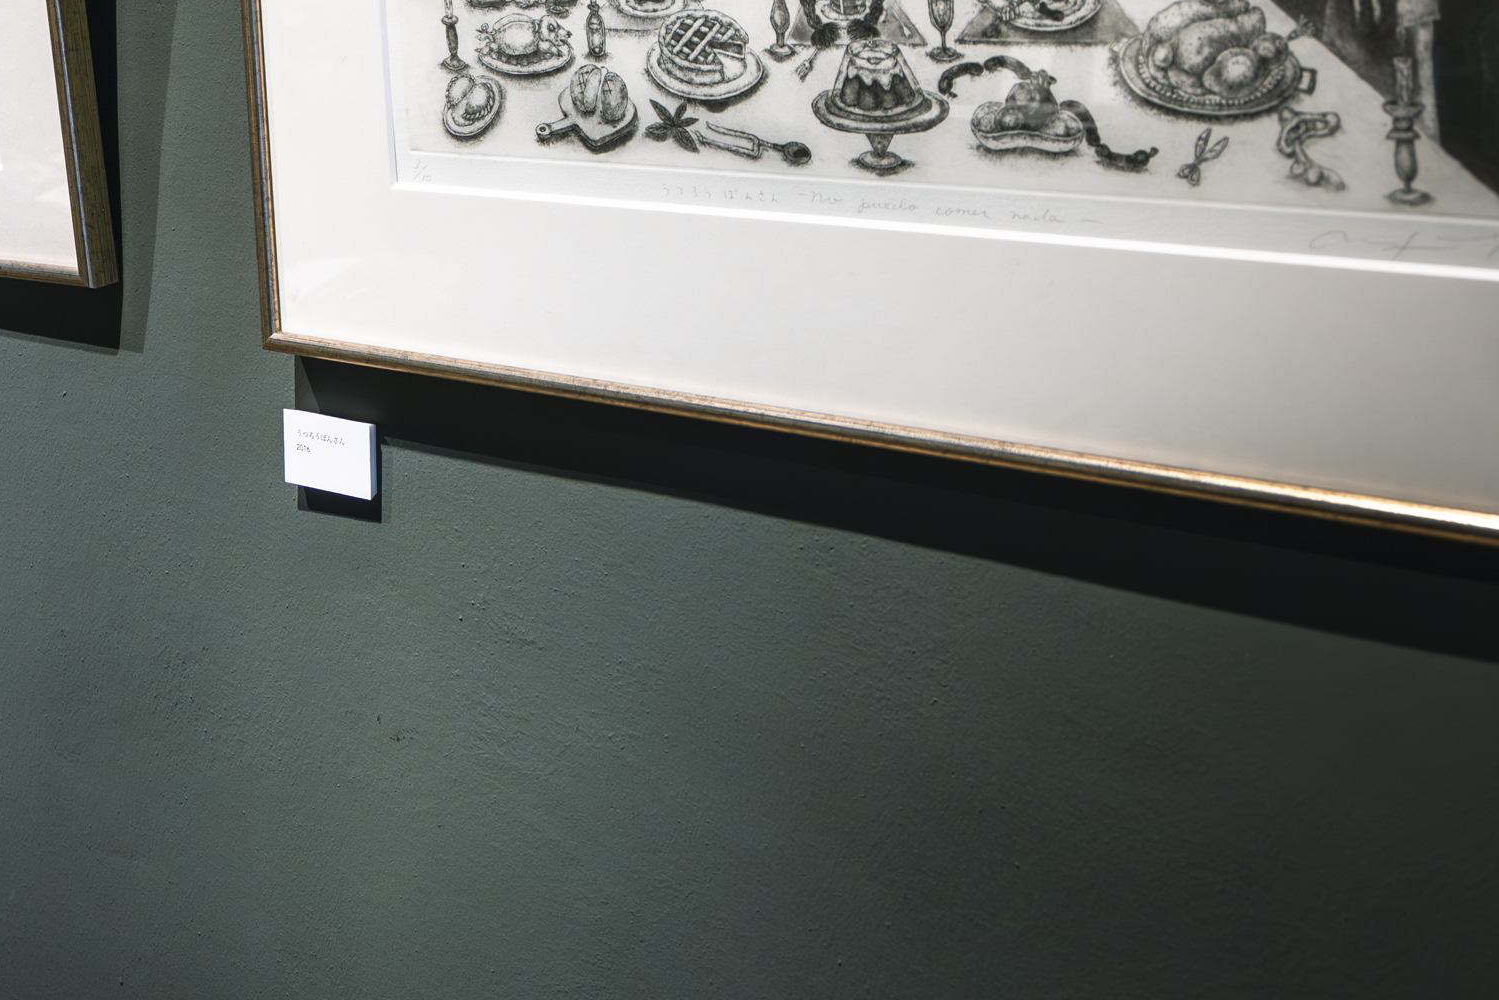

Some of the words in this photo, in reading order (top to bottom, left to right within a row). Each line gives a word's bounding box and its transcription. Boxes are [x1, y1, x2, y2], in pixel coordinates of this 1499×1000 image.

[857, 197, 920, 214] puedo
[935, 206, 994, 219] comer
[297, 429, 345, 446] うつろうばんさん
[296, 443, 311, 453] 2016
